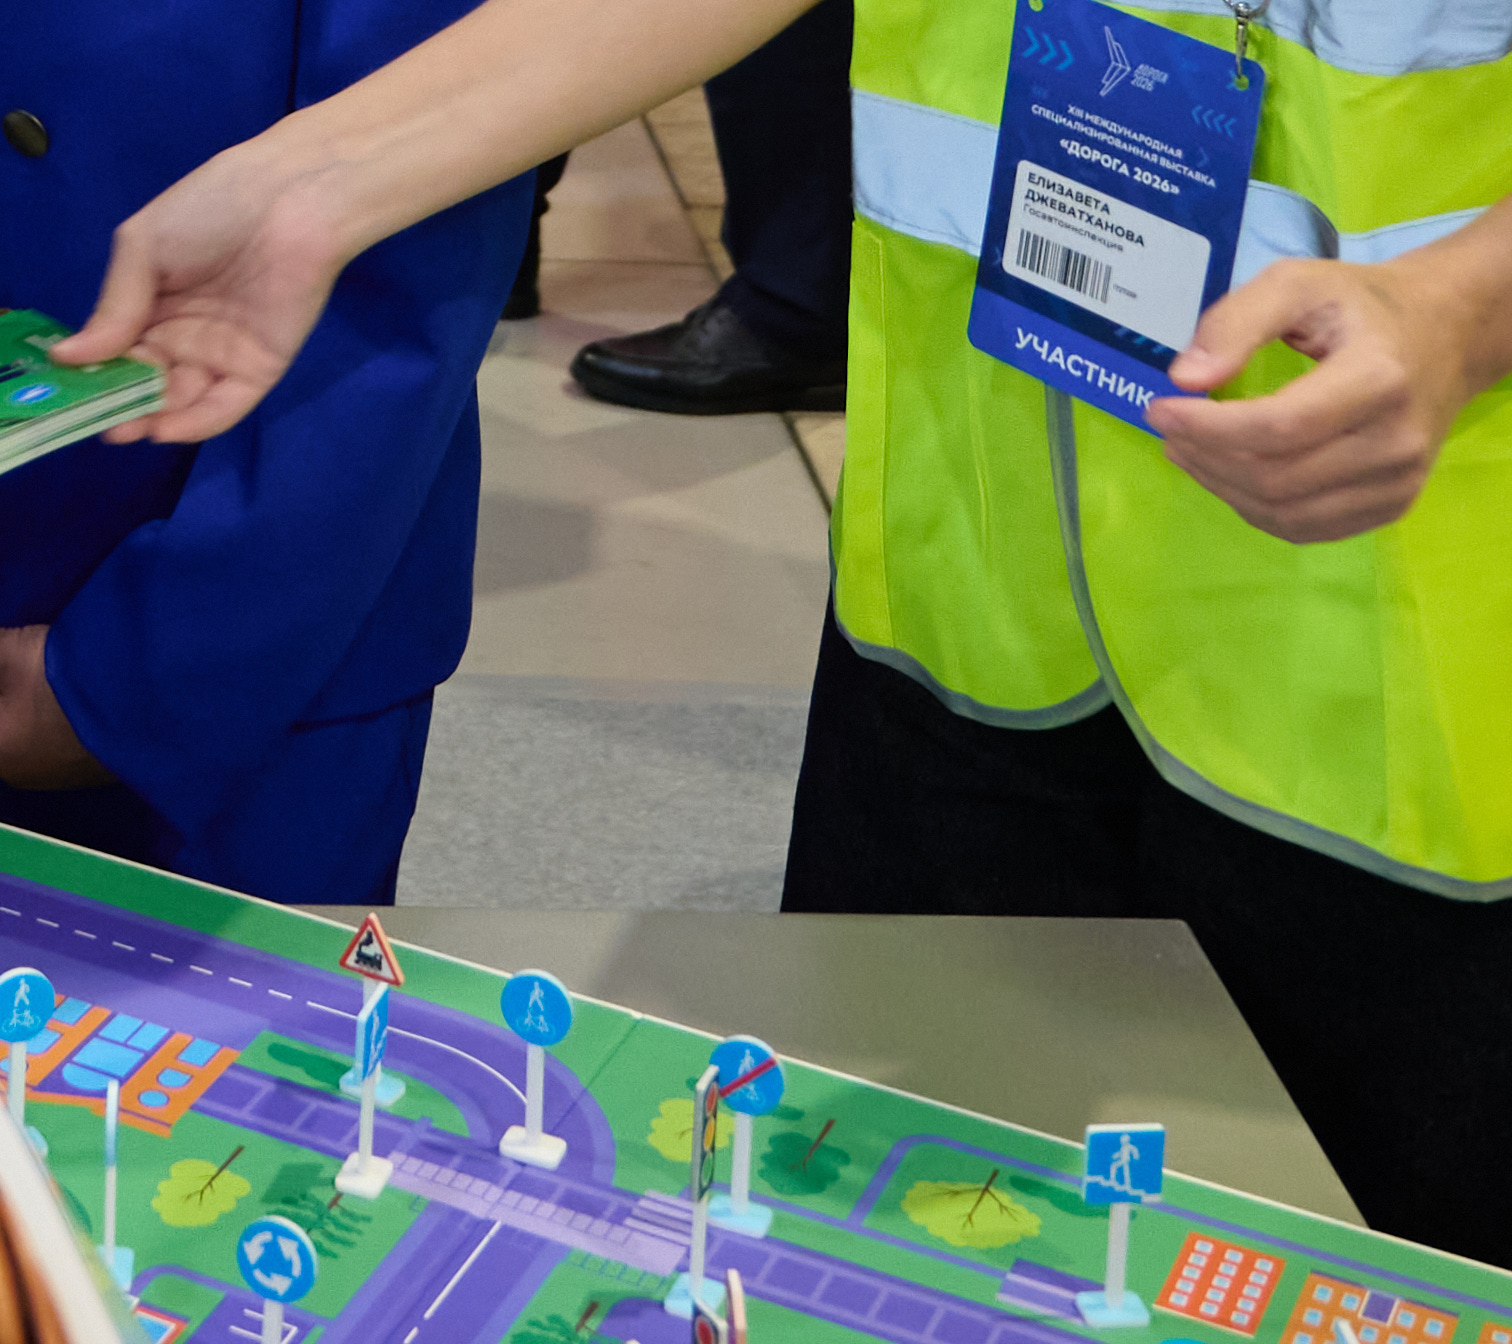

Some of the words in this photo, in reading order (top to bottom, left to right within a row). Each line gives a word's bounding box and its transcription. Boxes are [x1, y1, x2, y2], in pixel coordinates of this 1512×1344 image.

[1031, 104, 1158, 164] СПЕЦИАЛИЗИРОВАННАЯ
[1159, 151, 1216, 189] ВЫСТАВКА
[1085, 111, 1183, 159] МЕЖДУНАРОДНАЯ
[1027, 171, 1111, 216] ЕЛИЗАВЕТА
[1059, 138, 1130, 178] «ДОРОГА
[1133, 166, 1180, 196] 2026»
[1022, 203, 1125, 253] Госавтоинспекция
[1024, 187, 1146, 248] ДЖЕВАТХАНОВА
[1014, 326, 1155, 412] УЧАСТНИК
